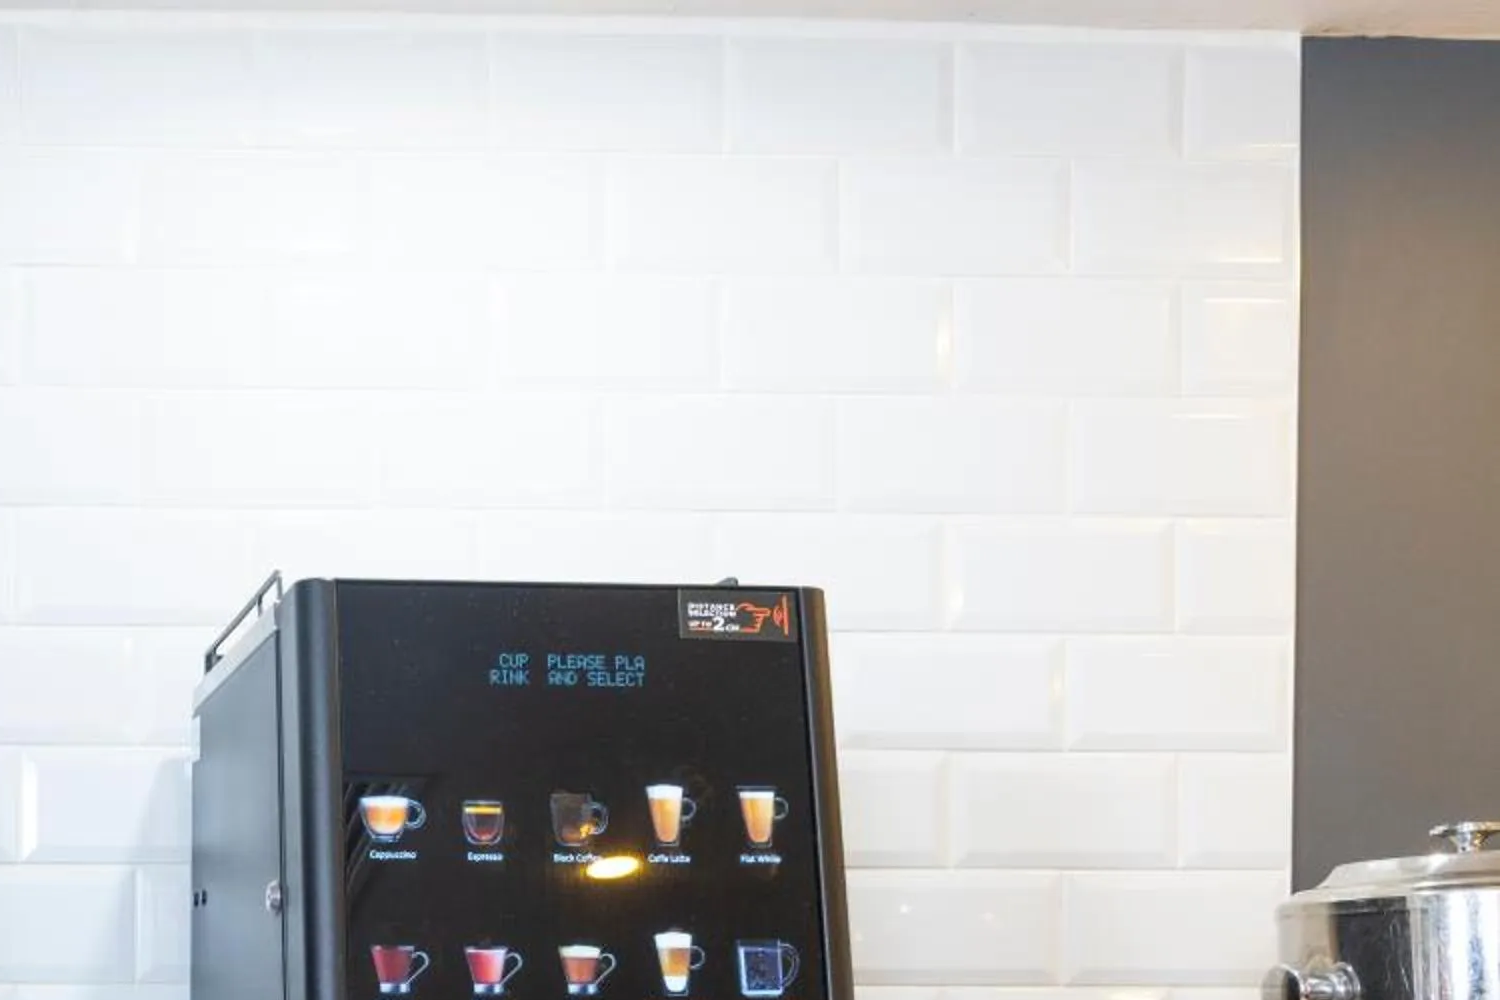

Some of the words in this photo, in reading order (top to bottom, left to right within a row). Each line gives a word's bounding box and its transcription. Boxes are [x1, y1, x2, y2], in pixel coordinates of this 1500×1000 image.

[712, 616, 725, 632] 2
[499, 653, 530, 668] CUP
[547, 653, 606, 669] PLEASE
[615, 655, 645, 671] PLA
[490, 669, 530, 686] RINK
[548, 671, 578, 686] AND
[587, 671, 645, 687] SELECT
[369, 850, 417, 860] Cappuccino
[467, 851, 503, 862] Espresso
[553, 853, 574, 862] Black
[739, 854, 756, 863] Flat
[757, 854, 782, 864] White
